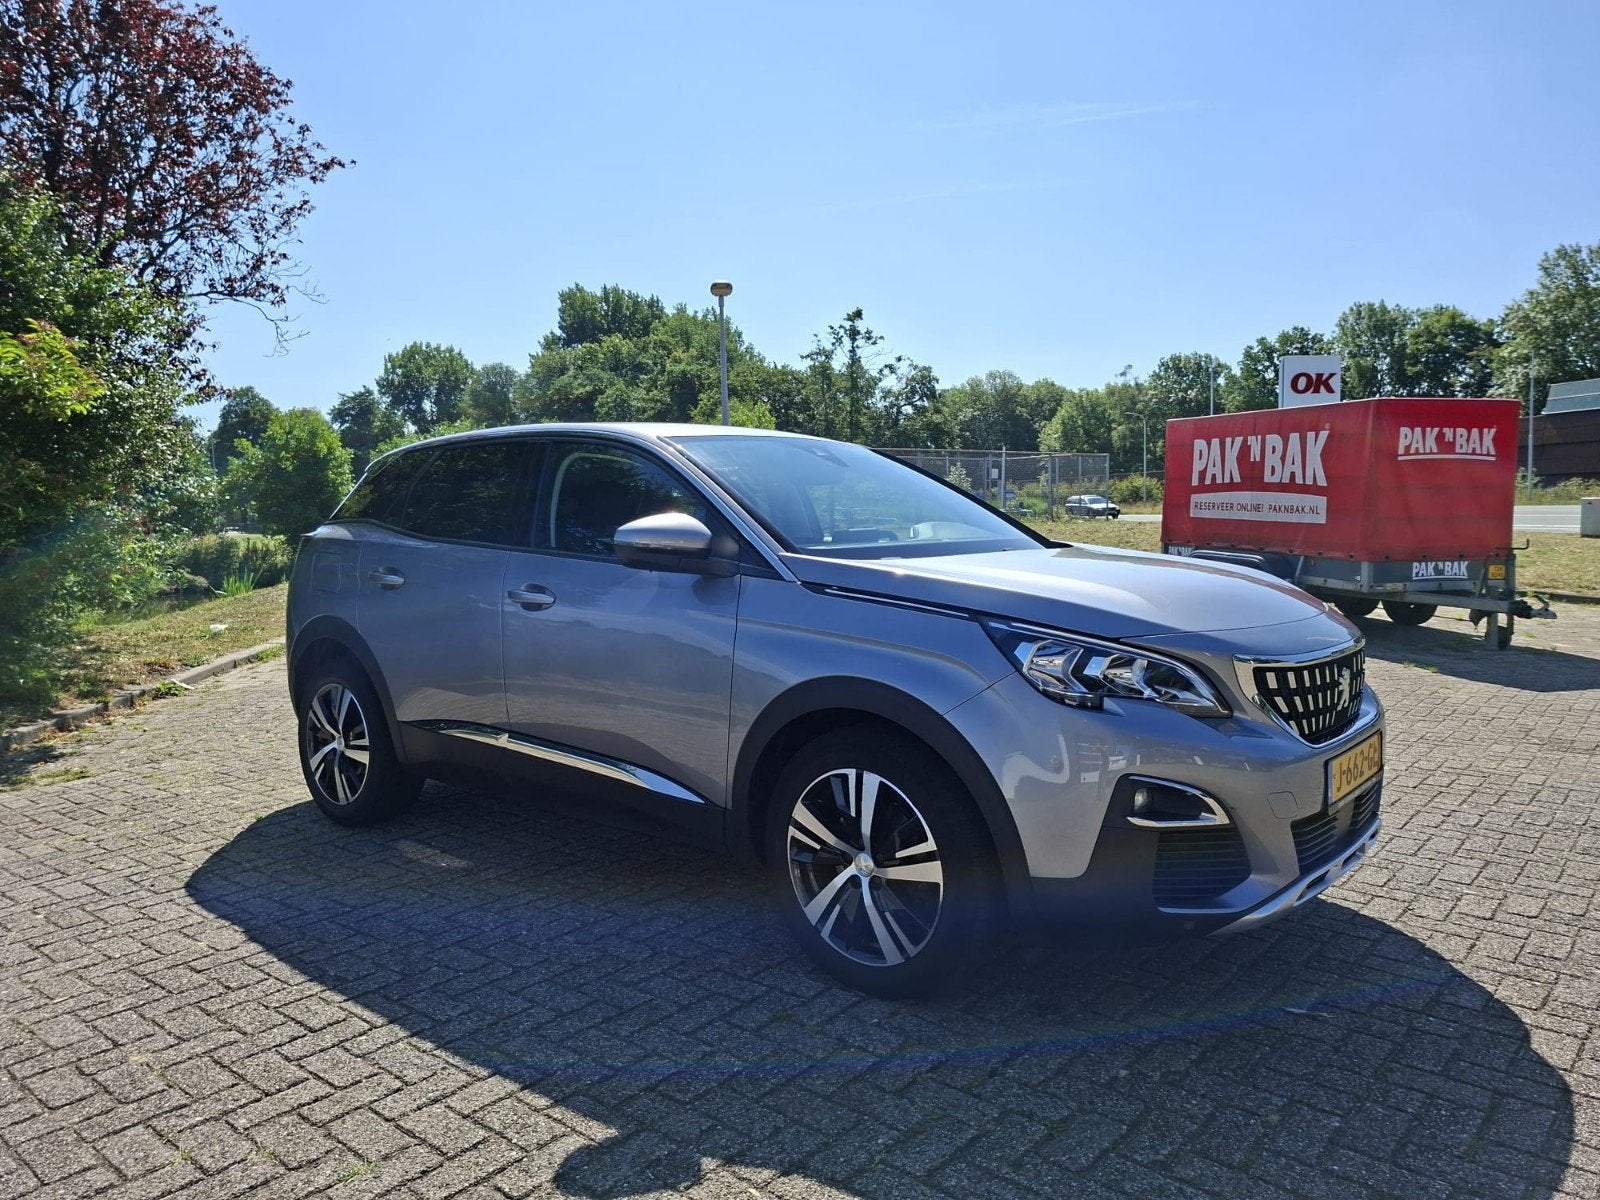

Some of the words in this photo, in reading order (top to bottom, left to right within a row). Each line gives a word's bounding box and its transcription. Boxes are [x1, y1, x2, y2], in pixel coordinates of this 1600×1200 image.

[1290, 372, 1337, 394] OK
[1398, 426, 1440, 455] PAK
[1455, 427, 1497, 455] BAK
[1191, 436, 1243, 486] PAK
[1264, 430, 1330, 487] BAK
[1194, 501, 1235, 512] RESERVEER
[1236, 502, 1264, 513] ONLINE!
[1268, 504, 1321, 515] PAKNBAK.NL
[1412, 561, 1436, 578] PAK
[1444, 560, 1469, 577] BAK
